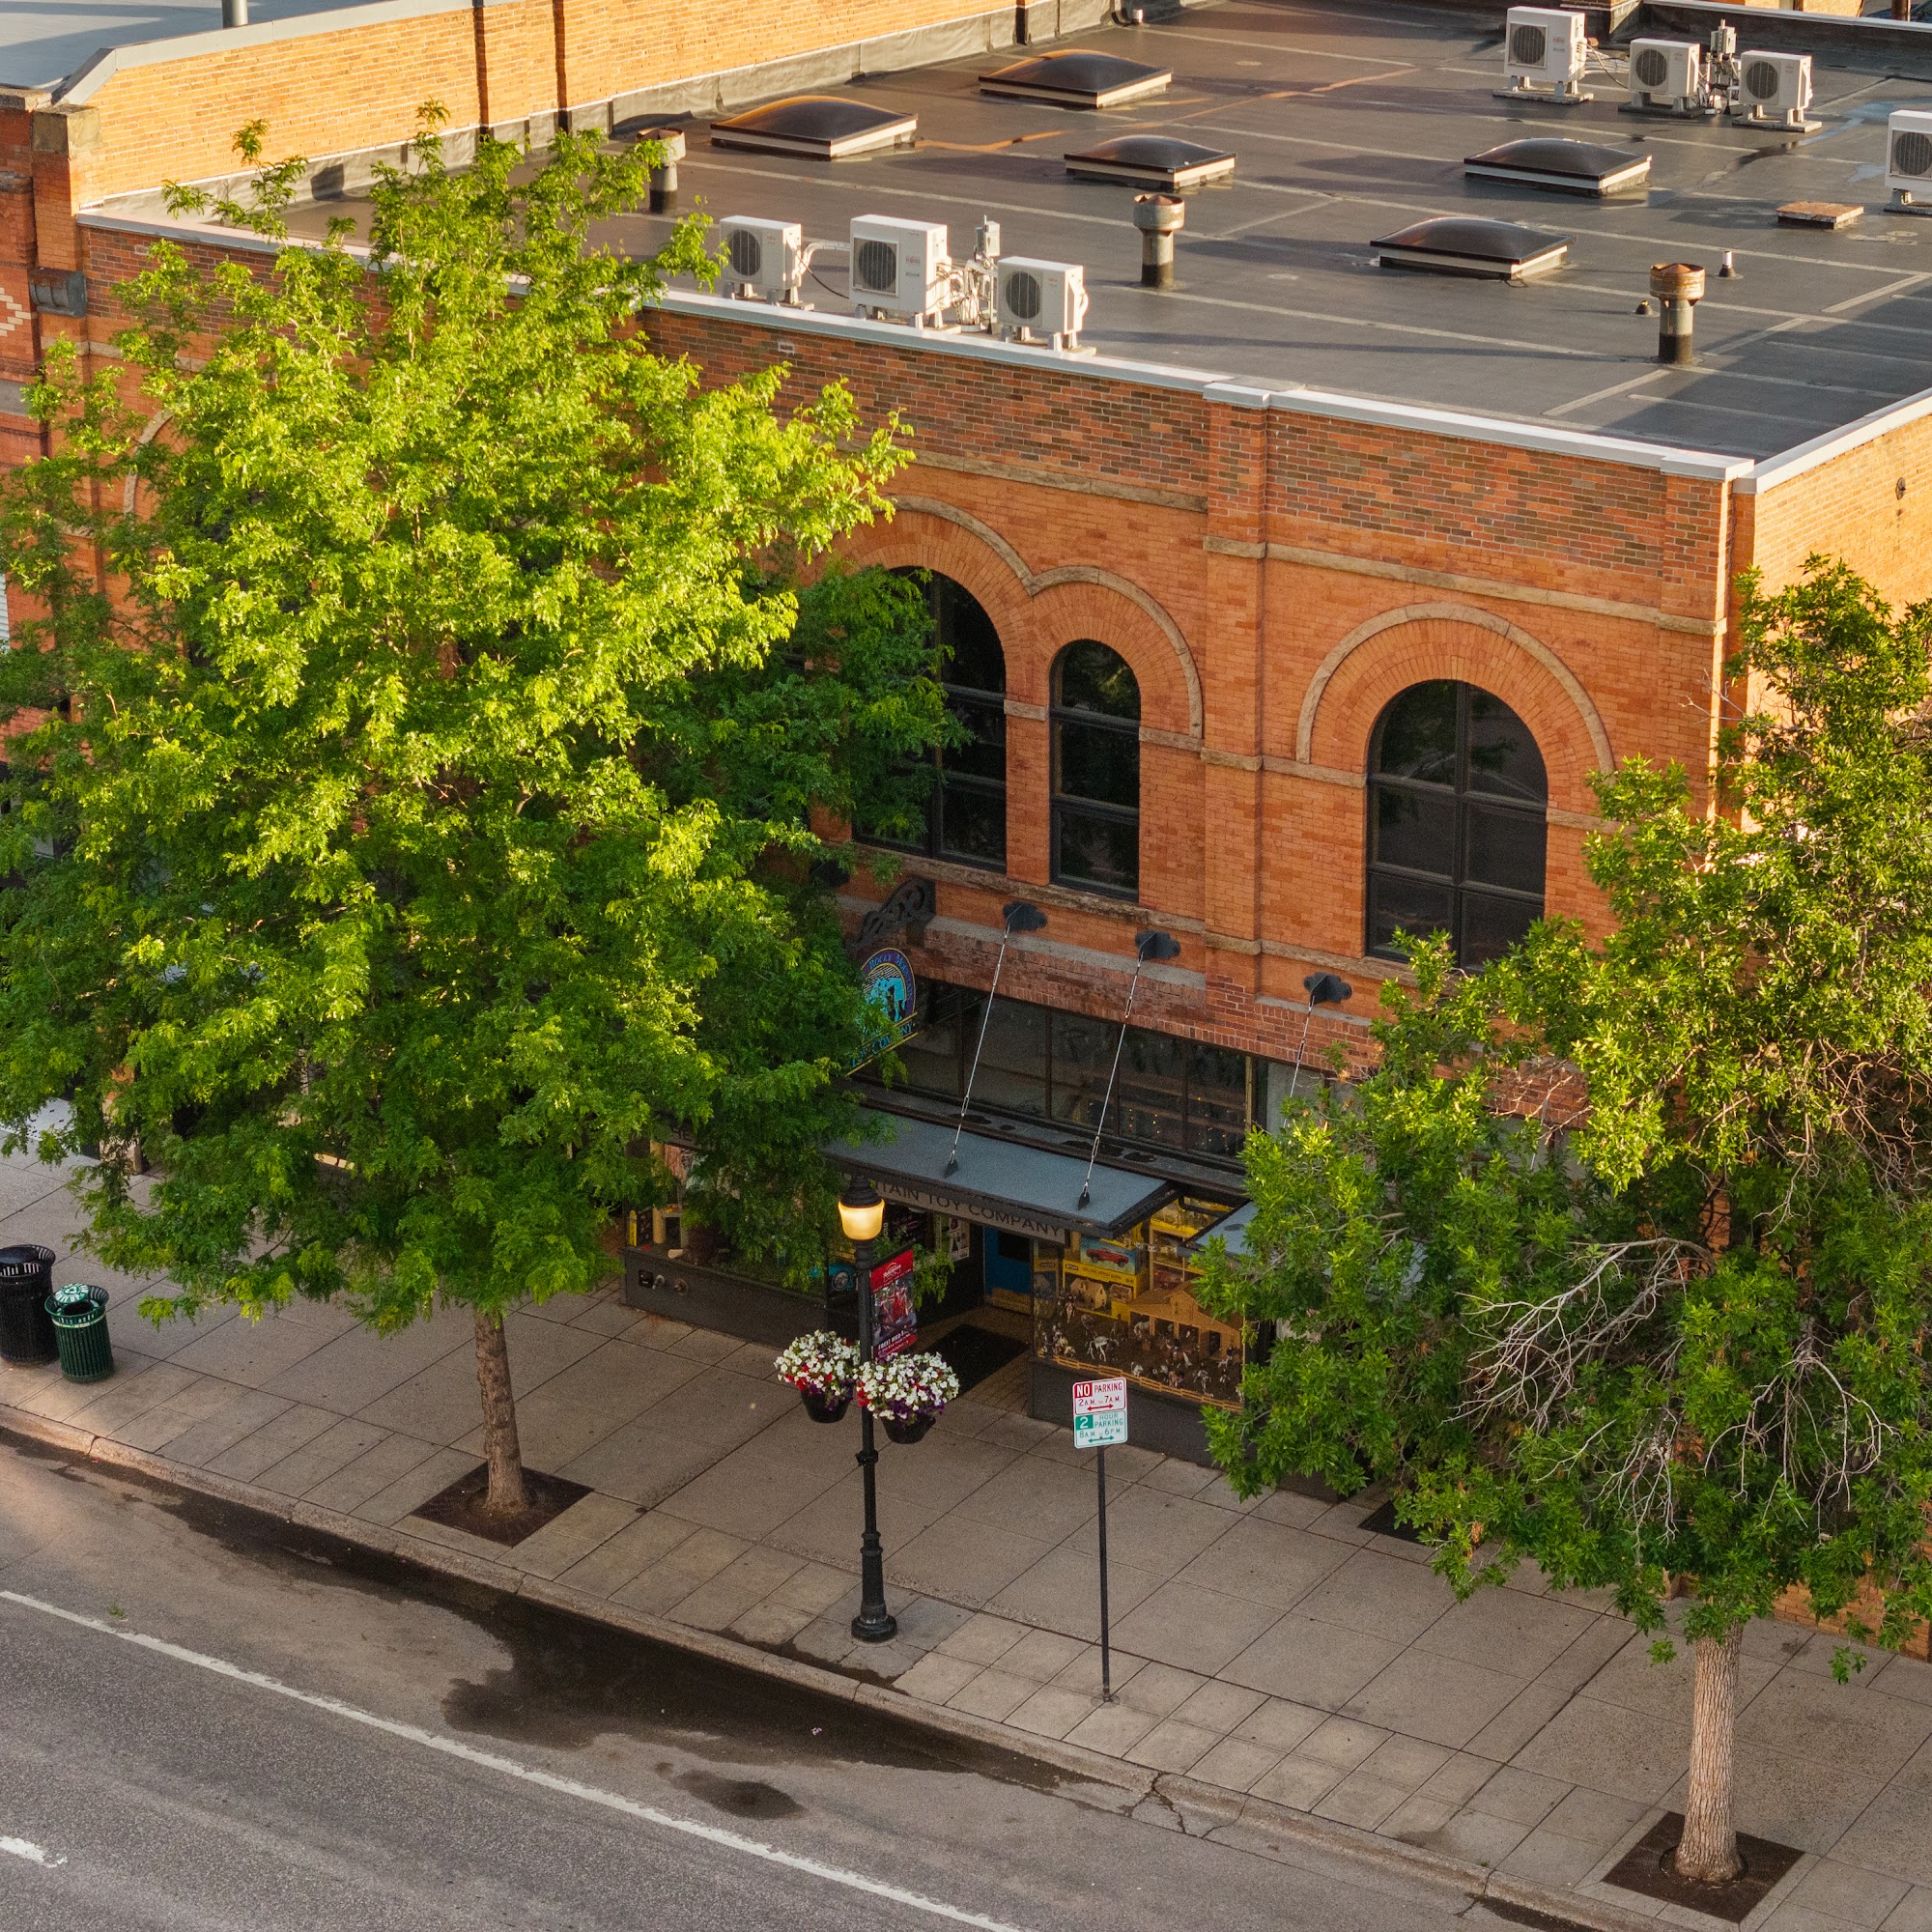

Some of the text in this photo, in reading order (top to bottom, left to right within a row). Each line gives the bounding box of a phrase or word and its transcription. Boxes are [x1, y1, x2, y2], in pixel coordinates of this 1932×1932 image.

[926, 1193, 961, 1210] TOY
[968, 1204, 1061, 1236] COMPANY
[1076, 1382, 1122, 1397] NO PARKING
[1079, 1417, 1089, 1429] 2
[1094, 1419, 1123, 1428] PARKING
